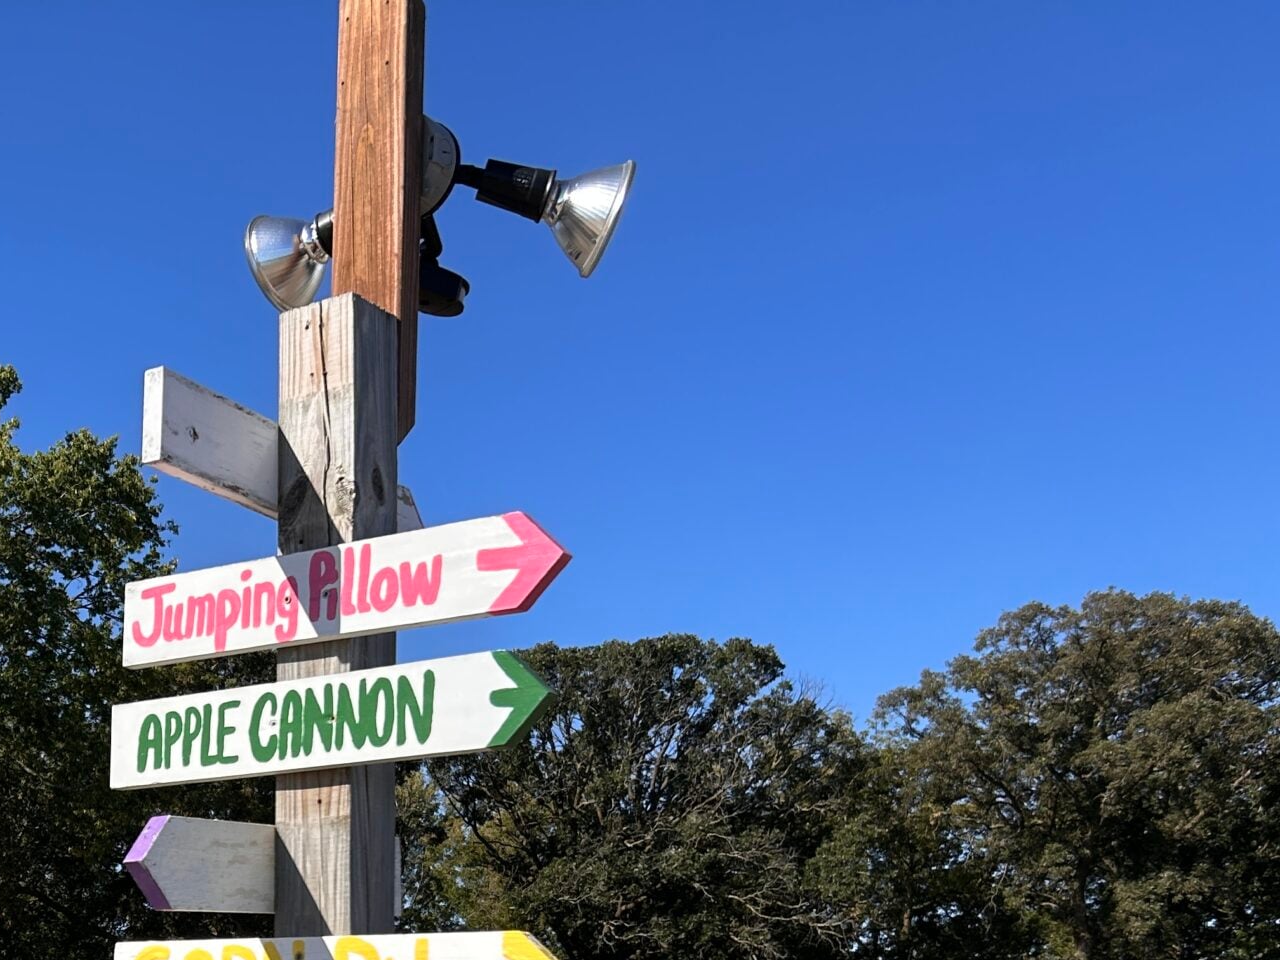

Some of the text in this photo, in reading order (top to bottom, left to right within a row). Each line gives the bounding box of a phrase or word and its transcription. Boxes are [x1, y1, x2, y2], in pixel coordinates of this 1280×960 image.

[132, 543, 442, 652] Jumping Pillow
[136, 669, 436, 774] APPLE CANNON
